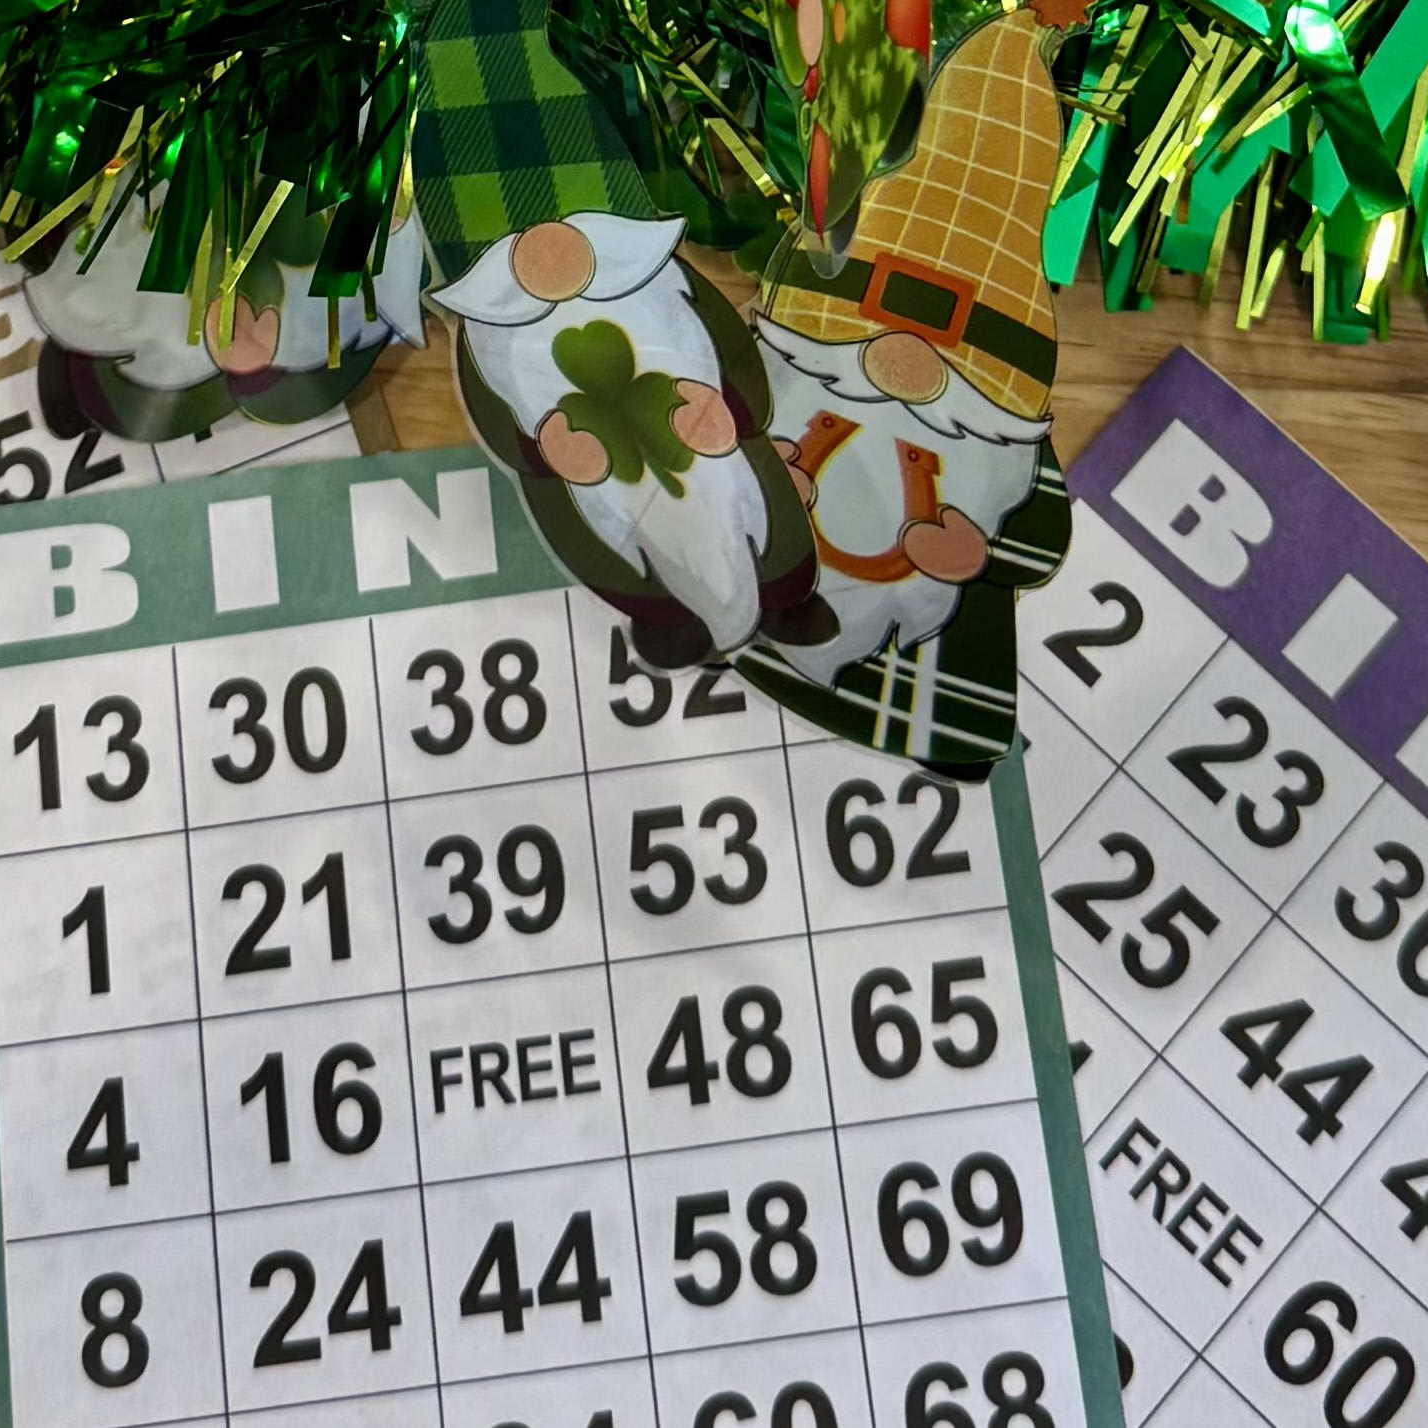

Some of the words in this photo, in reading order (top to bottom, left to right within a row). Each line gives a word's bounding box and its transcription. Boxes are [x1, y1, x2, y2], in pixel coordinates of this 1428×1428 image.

[13, 696, 150, 812] 13
[209, 667, 348, 786] 30
[407, 638, 548, 757] 38
[1042, 581, 1145, 688] 2
[1167, 696, 1326, 849] 23
[62, 886, 110, 995] 1
[222, 851, 352, 977] 21
[424, 825, 566, 945] 39
[630, 796, 768, 918] 53
[825, 772, 970, 889] 62
[1051, 832, 1222, 991] 25
[1219, 999, 1375, 1147] 44
[66, 1077, 141, 1188] 4
[240, 1042, 383, 1165] 16
[430, 1029, 601, 1114] FREE
[647, 985, 793, 1107] 48
[851, 957, 999, 1080] 65
[80, 1272, 150, 1389] 8
[249, 1239, 403, 1369] 24
[459, 1211, 612, 1334] 44
[673, 1181, 818, 1308] 58
[876, 1153, 1025, 1278] 69
[1099, 1117, 1265, 1289] FREE
[1264, 1280, 1417, 1428] 60
